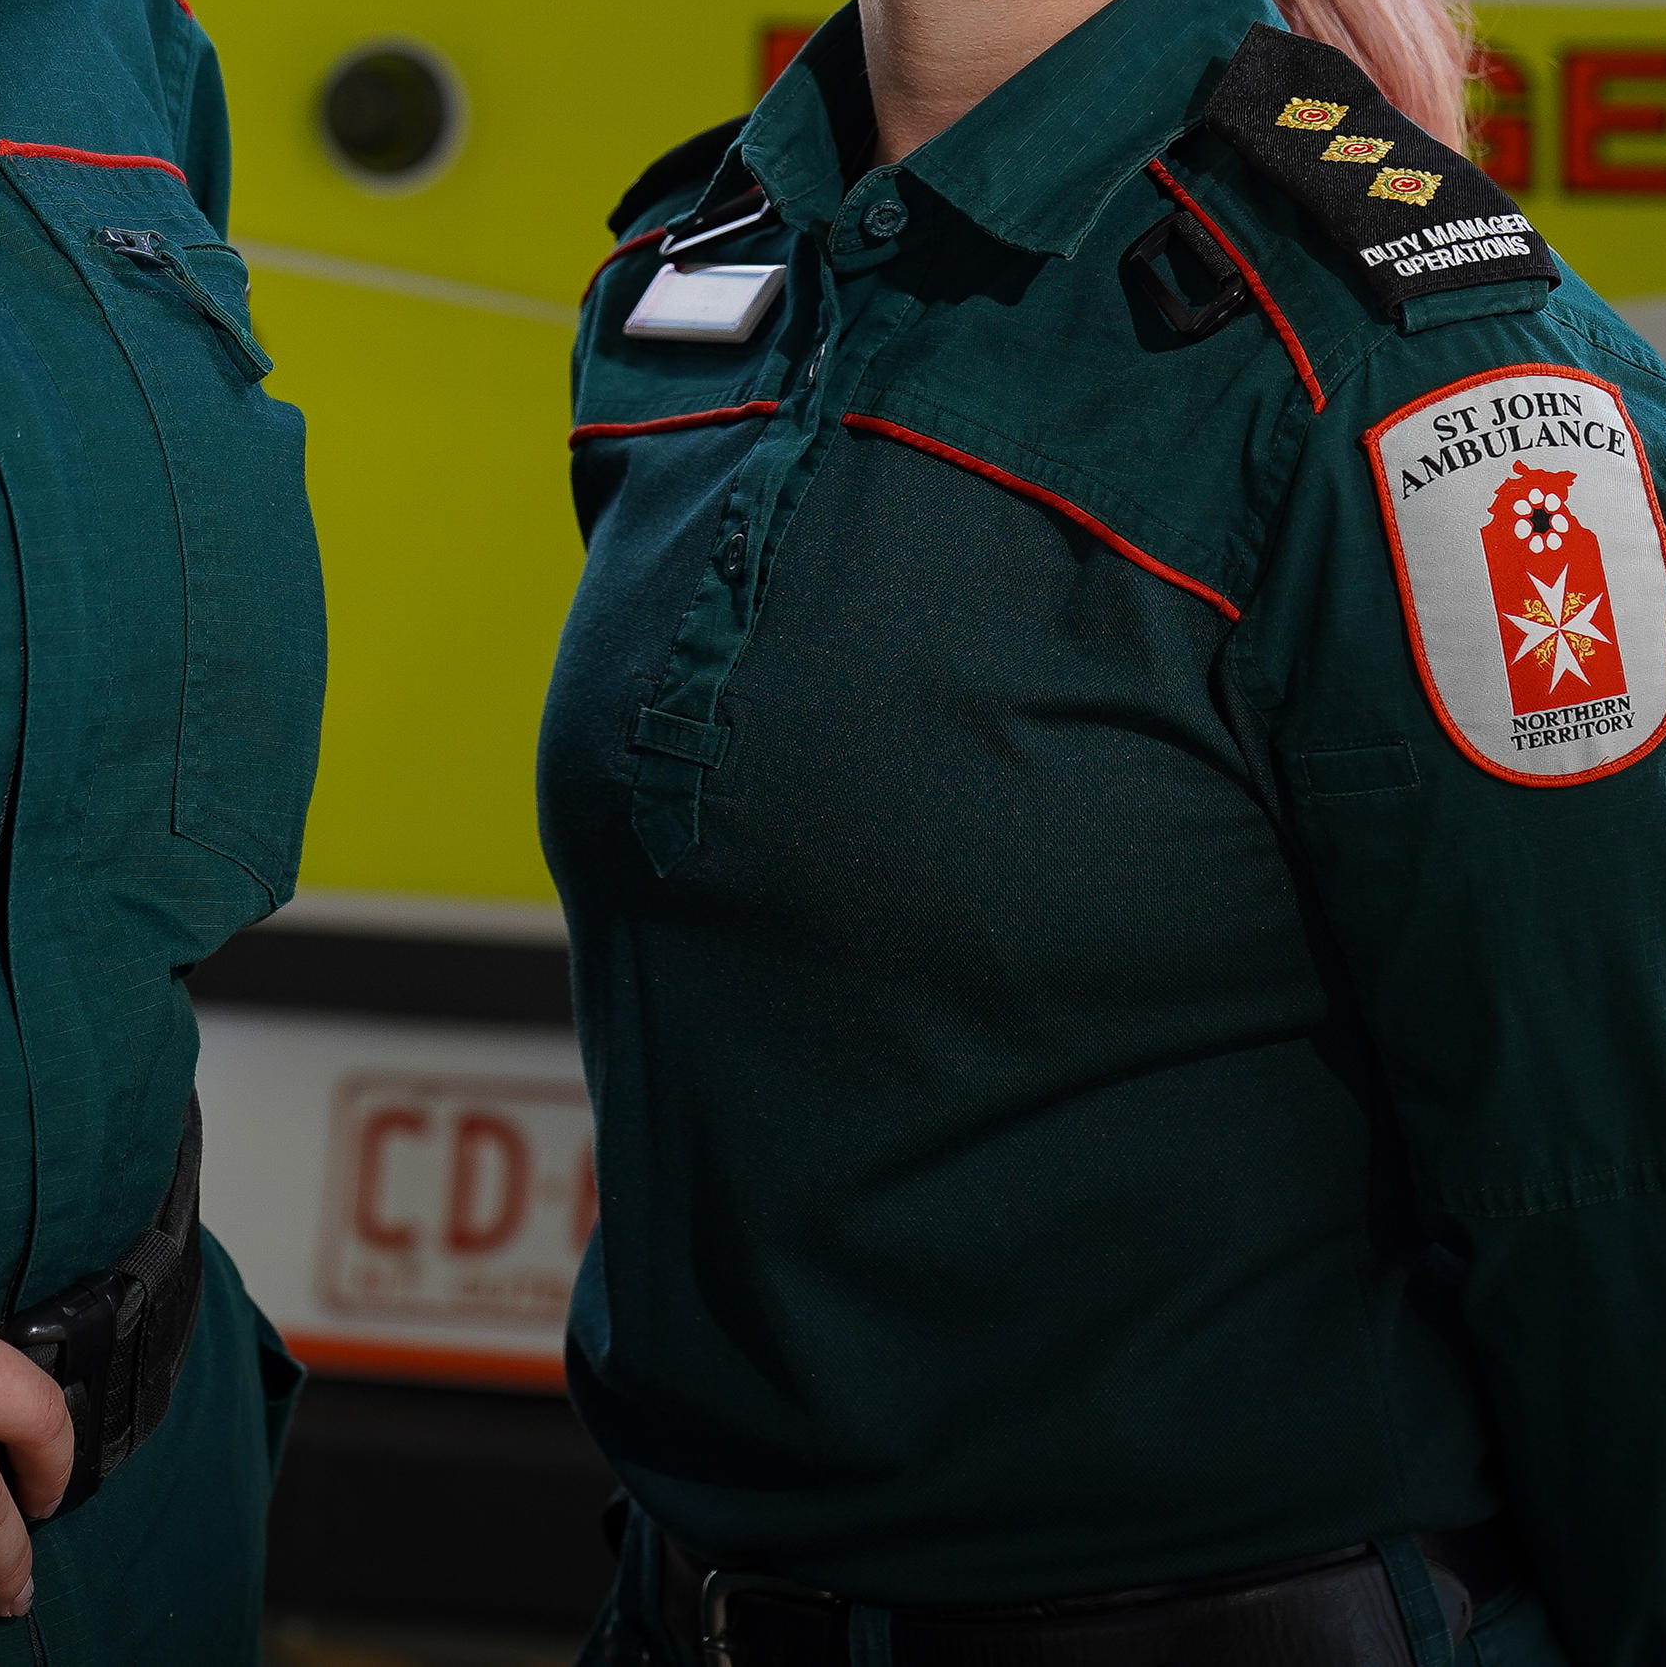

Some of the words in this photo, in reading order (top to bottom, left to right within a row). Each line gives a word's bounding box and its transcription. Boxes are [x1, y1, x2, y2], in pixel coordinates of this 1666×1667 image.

[1360, 233, 1421, 267] DUTY
[1422, 213, 1533, 247] MANAGER
[1394, 235, 1531, 277] OPERATIONS
[1432, 406, 1482, 443] ST
[1491, 392, 1583, 427] JOHN
[1397, 420, 1627, 500] AMBULANCE
[1510, 711, 1637, 752] TERRITORY
[1511, 696, 1632, 734] NORTHERN
